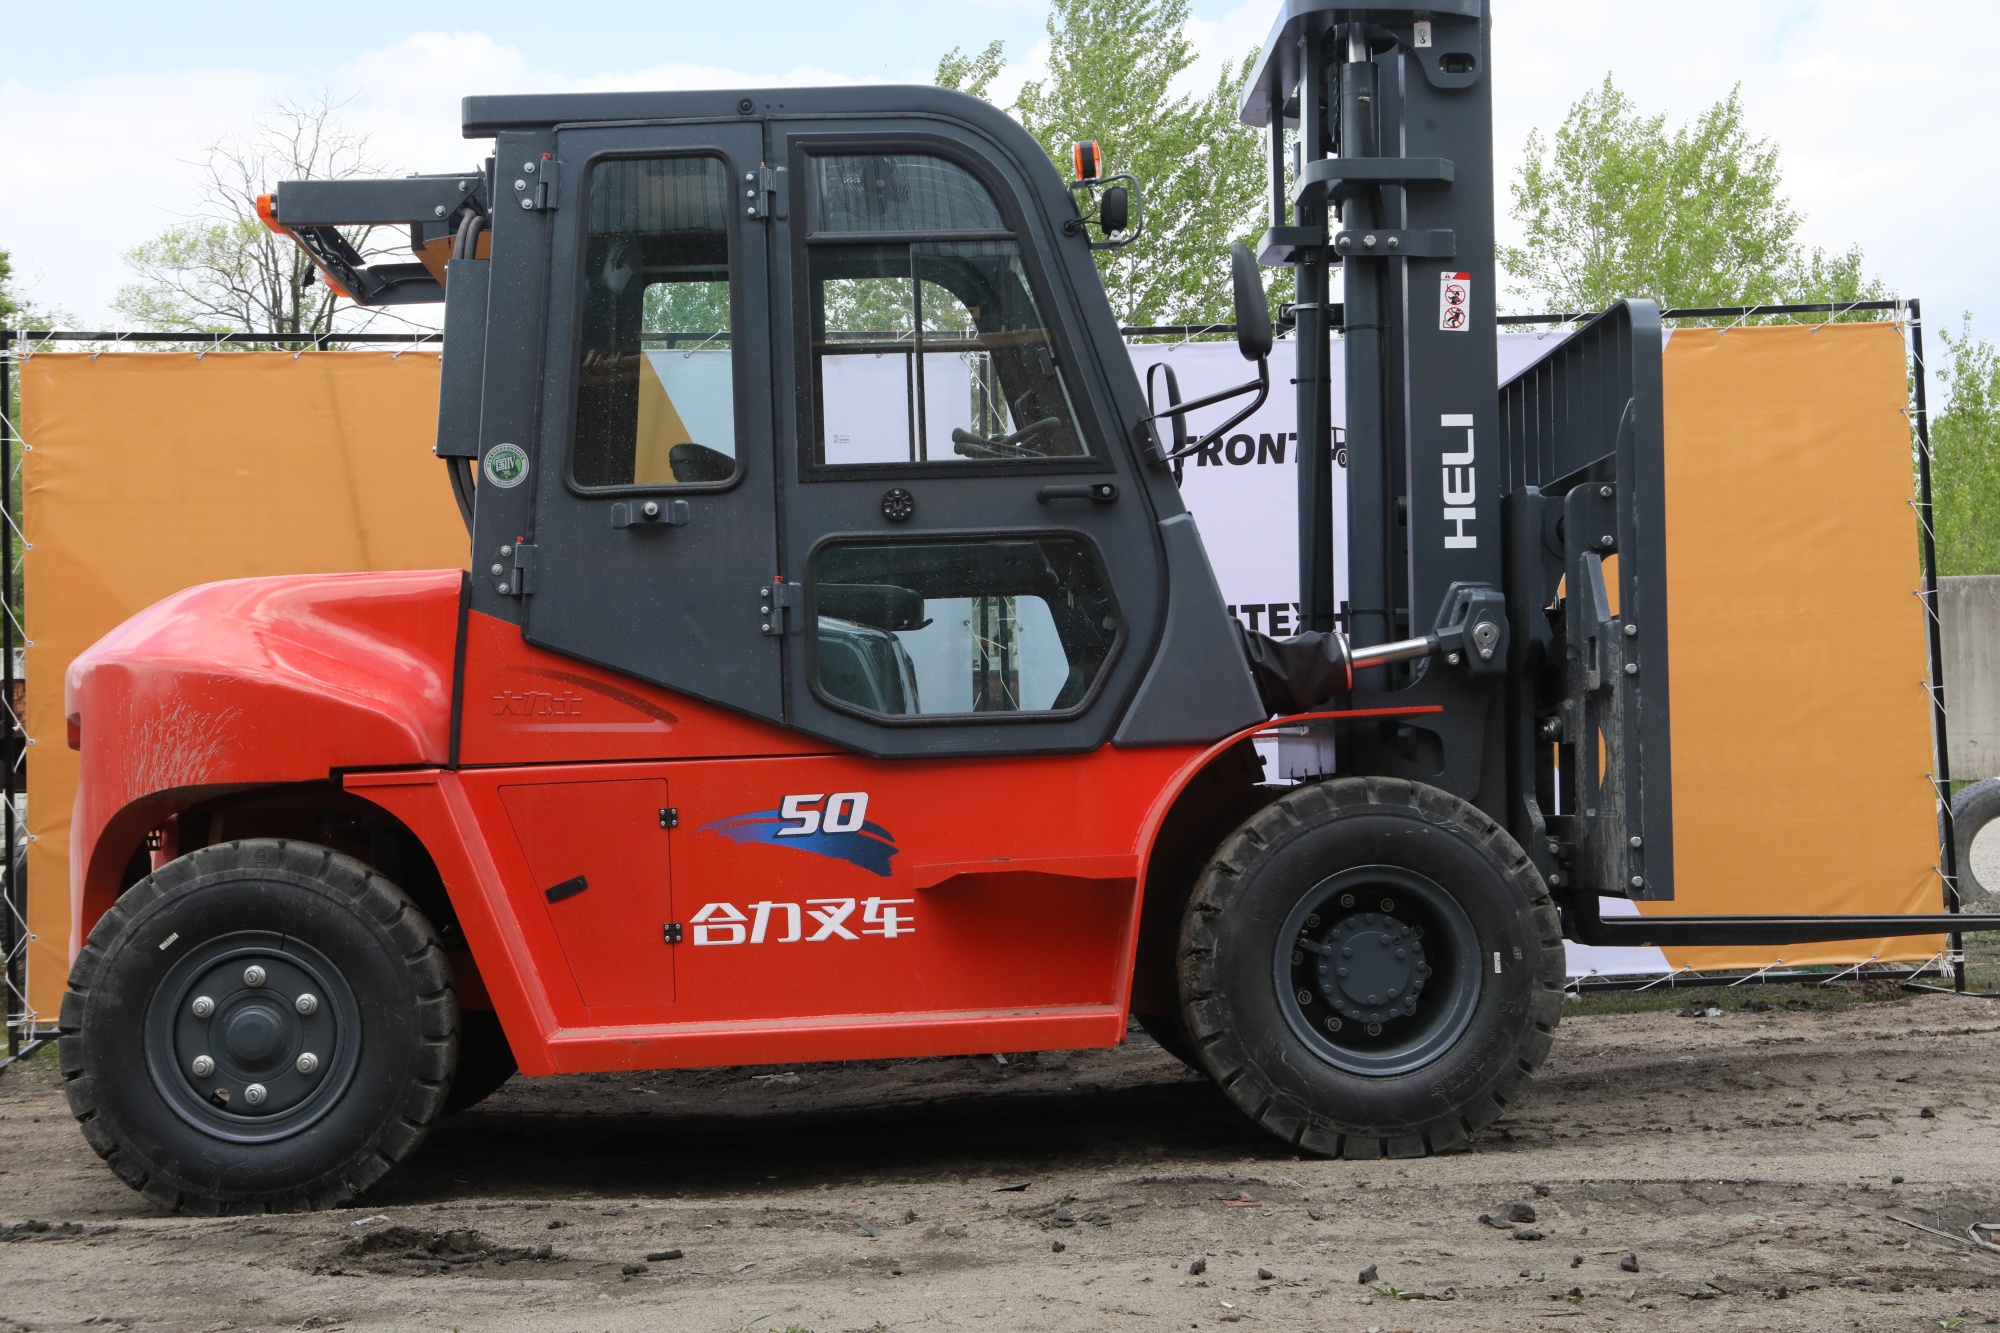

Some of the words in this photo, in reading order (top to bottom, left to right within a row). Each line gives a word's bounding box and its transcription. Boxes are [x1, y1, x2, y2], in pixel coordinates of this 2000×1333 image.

[1441, 414, 1477, 548] HELI
[492, 690, 583, 717] 大力士
[776, 791, 869, 837] 50
[688, 896, 916, 947] 合力叉车
